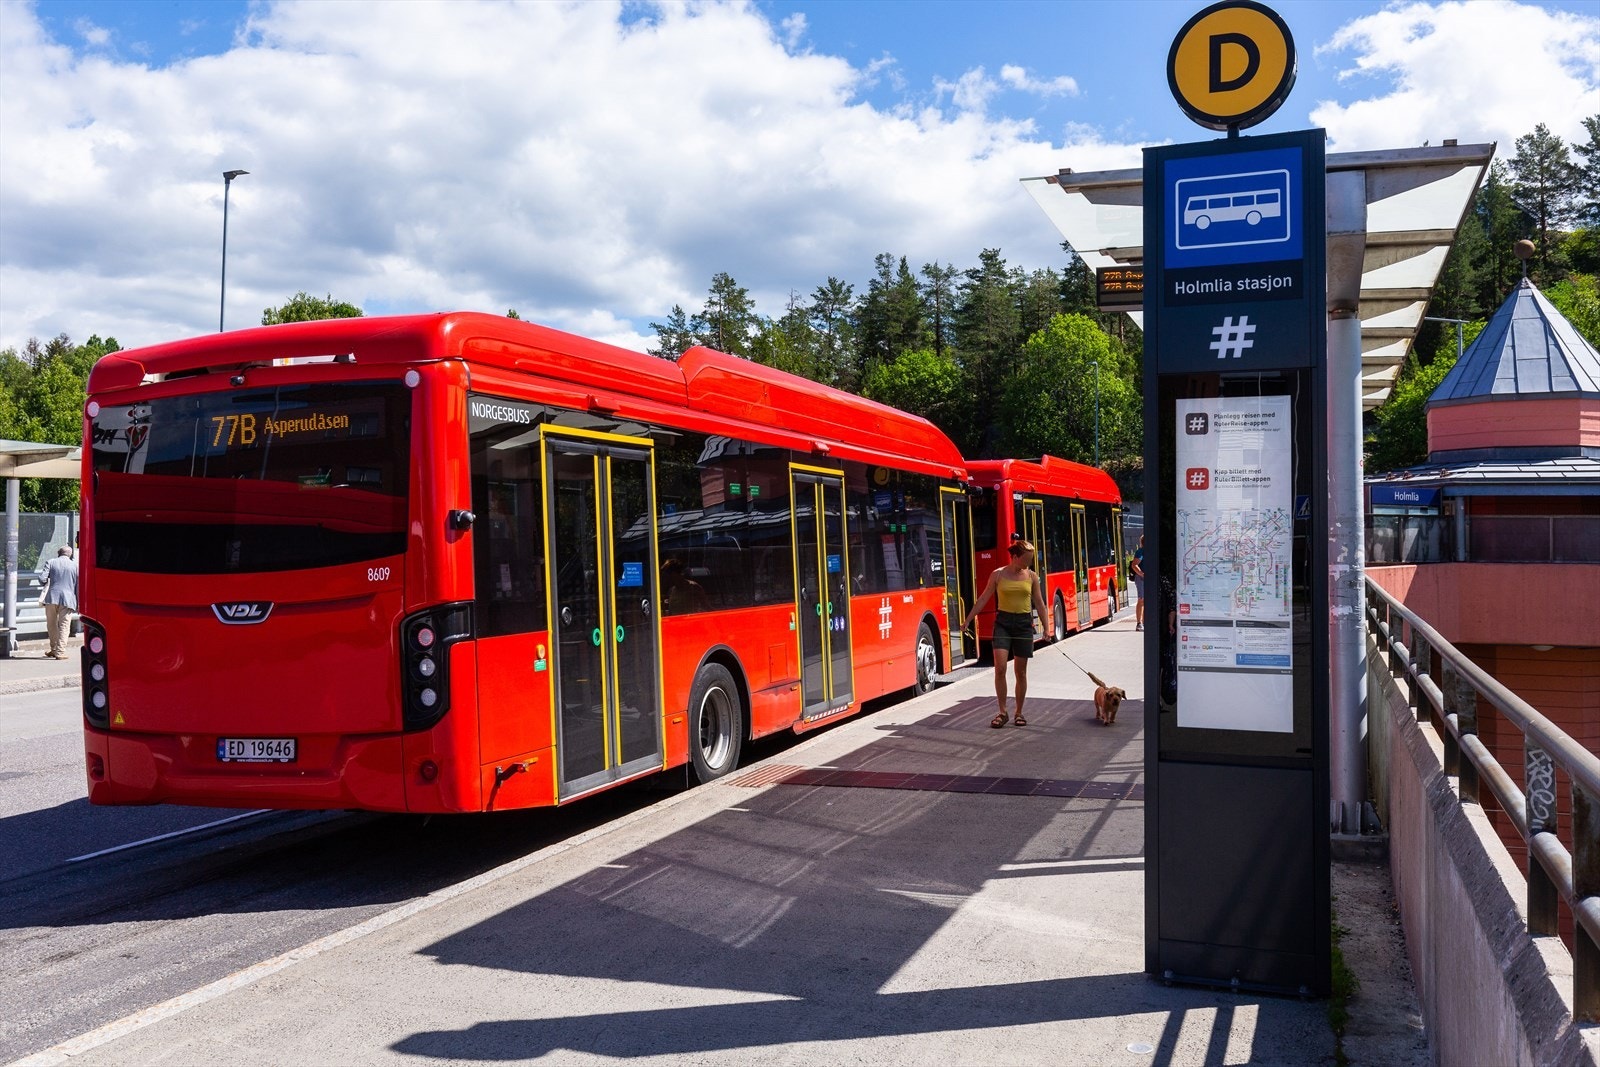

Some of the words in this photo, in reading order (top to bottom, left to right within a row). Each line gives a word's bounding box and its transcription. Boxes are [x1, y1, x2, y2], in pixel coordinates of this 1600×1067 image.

[1209, 32, 1261, 94] D
[1175, 278, 1233, 295] Holmlia
[1237, 275, 1292, 292] stasjon
[471, 401, 530, 424] NORGESBUSS
[212, 413, 257, 447] 77B
[263, 412, 349, 438] Asperudåsen
[1394, 491, 1419, 501] Holmlia
[367, 566, 390, 581] 8609
[222, 604, 263, 617] VDL
[229, 740, 245, 756] ED
[251, 740, 291, 757] 19646
